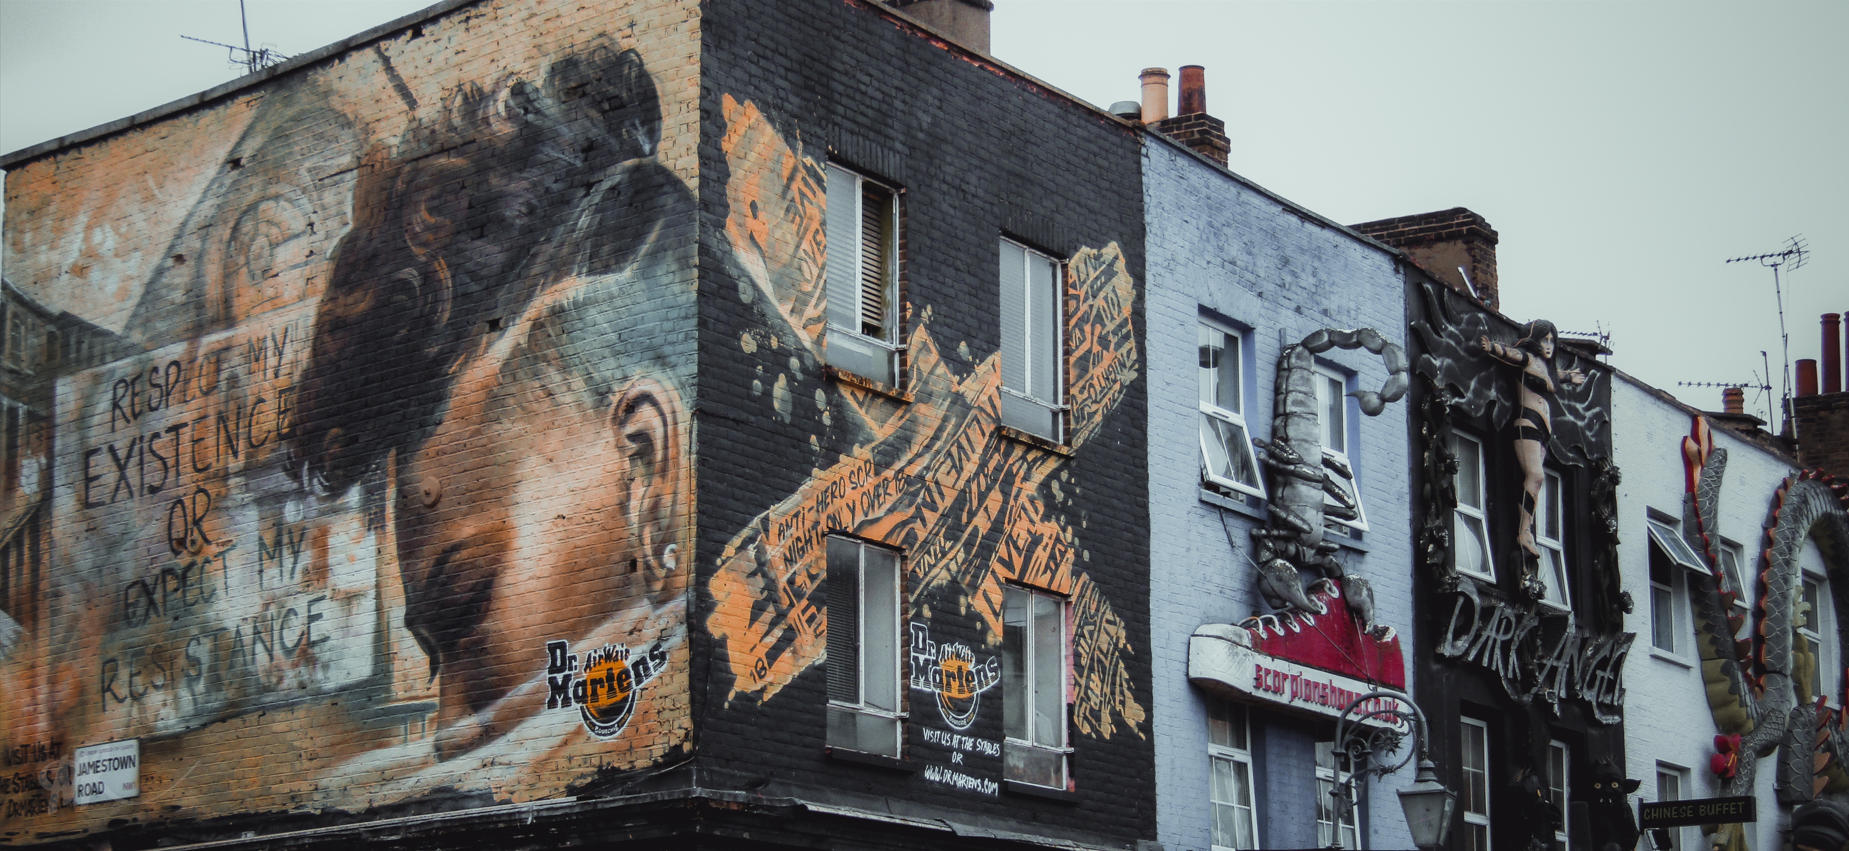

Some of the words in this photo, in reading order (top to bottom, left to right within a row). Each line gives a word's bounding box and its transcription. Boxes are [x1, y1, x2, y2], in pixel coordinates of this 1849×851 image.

[247, 327, 289, 379] MY
[83, 387, 297, 509] EXISTENCE
[860, 477, 892, 518] OVER
[168, 486, 212, 557] OR
[124, 539, 241, 628] EXPECT
[257, 526, 307, 588] MY
[101, 594, 330, 713] RESISTANCE
[1435, 577, 1540, 705] DARK
[546, 642, 668, 710] Martens
[911, 655, 1000, 694] Martens
[923, 727, 941, 743] VISIT
[941, 731, 951, 746] US
[952, 734, 961, 749] AT
[962, 736, 974, 751] THE
[976, 738, 1000, 757] STABLES
[951, 751, 963, 766] OR
[77, 754, 136, 777] JAMESTOWN
[77, 781, 105, 798] ROAD
[1643, 805, 1694, 820] CHINESE
[1699, 801, 1746, 817] BUFFET
